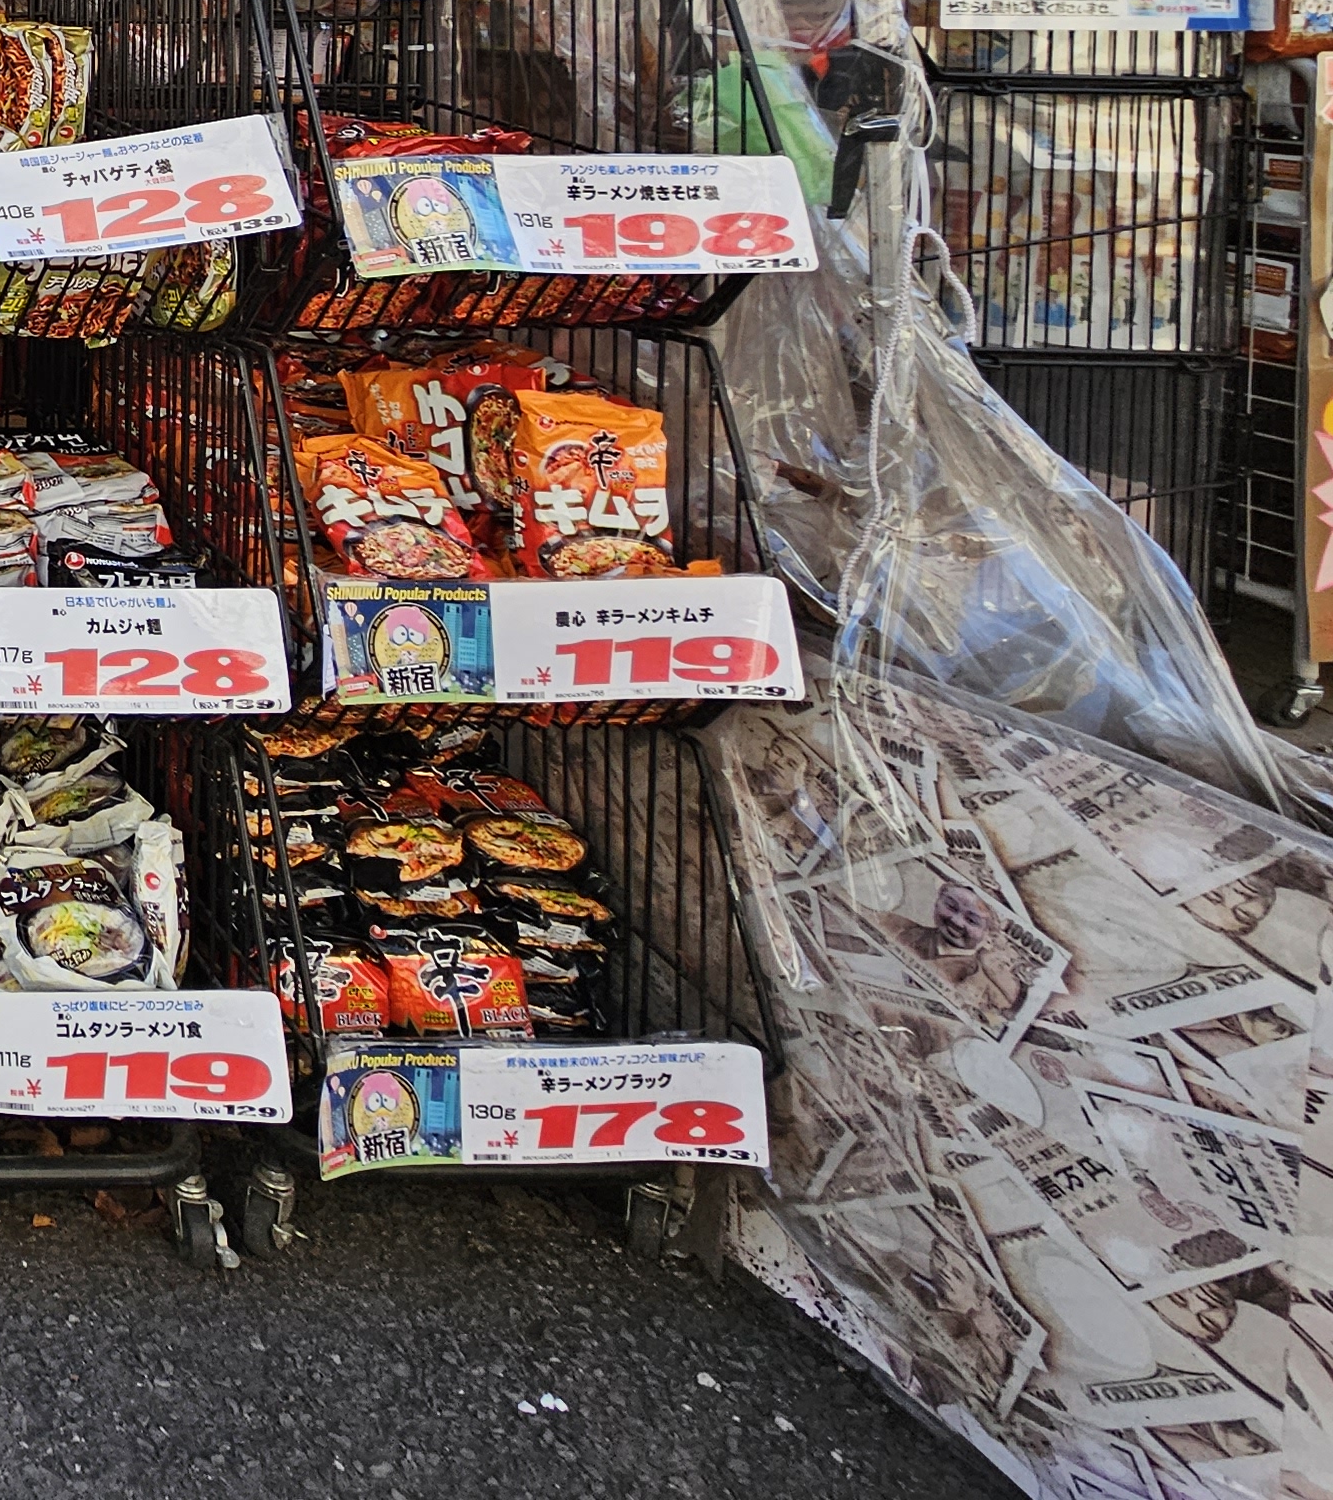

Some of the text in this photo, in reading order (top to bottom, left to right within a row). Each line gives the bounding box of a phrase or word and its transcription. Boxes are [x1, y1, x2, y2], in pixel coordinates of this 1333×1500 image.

[41, 174, 274, 244] 128
[514, 212, 553, 230] 131g
[563, 212, 795, 259] 198
[316, 484, 454, 529] キムチ
[534, 485, 669, 536] キムチ
[596, 608, 714, 625] 辛ラーメンキムチ
[45, 648, 269, 696] 128
[555, 636, 780, 686] 119
[387, 666, 436, 695] 新宿
[336, 1012, 382, 1027] BLACK
[482, 1008, 528, 1024] BLACK
[46, 1051, 272, 1101] 119
[540, 1073, 672, 1091] 辛ラーメンブラック
[468, 1103, 516, 1121] 130g
[522, 1101, 745, 1150] 178
[362, 1131, 407, 1162] 新宿
